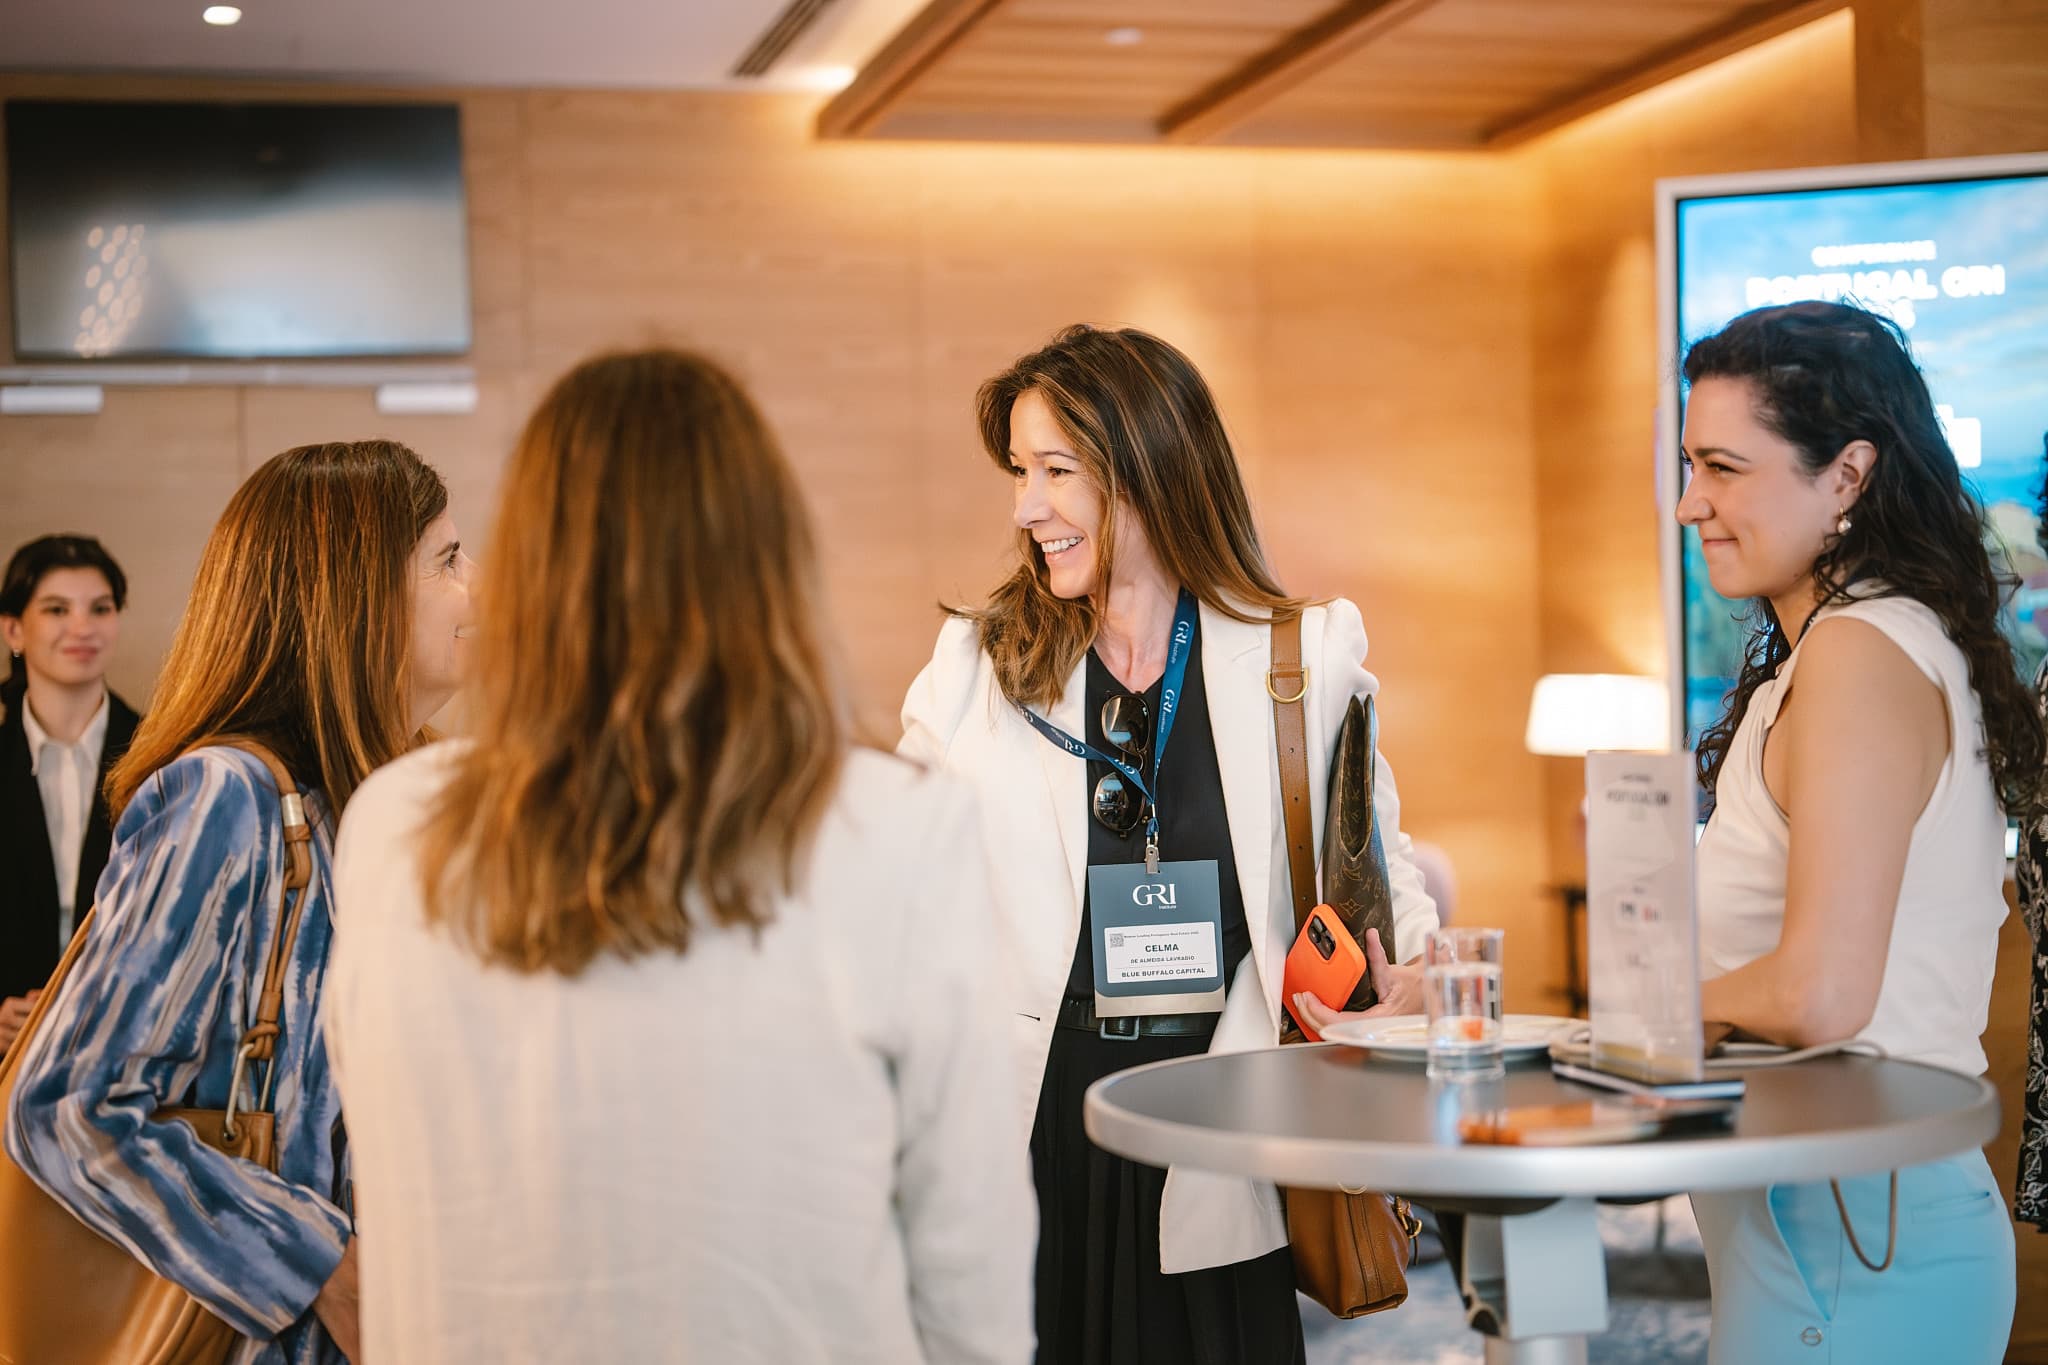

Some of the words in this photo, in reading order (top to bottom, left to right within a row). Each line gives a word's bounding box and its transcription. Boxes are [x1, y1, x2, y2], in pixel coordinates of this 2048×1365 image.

[1175, 621, 1190, 644] GRI
[1163, 689, 1175, 713] GRI
[1132, 883, 1177, 906] GRI
[1145, 943, 1179, 953] CELMA
[1142, 969, 1174, 977] BUFFALO
[1175, 967, 1206, 975] CAPITAL
